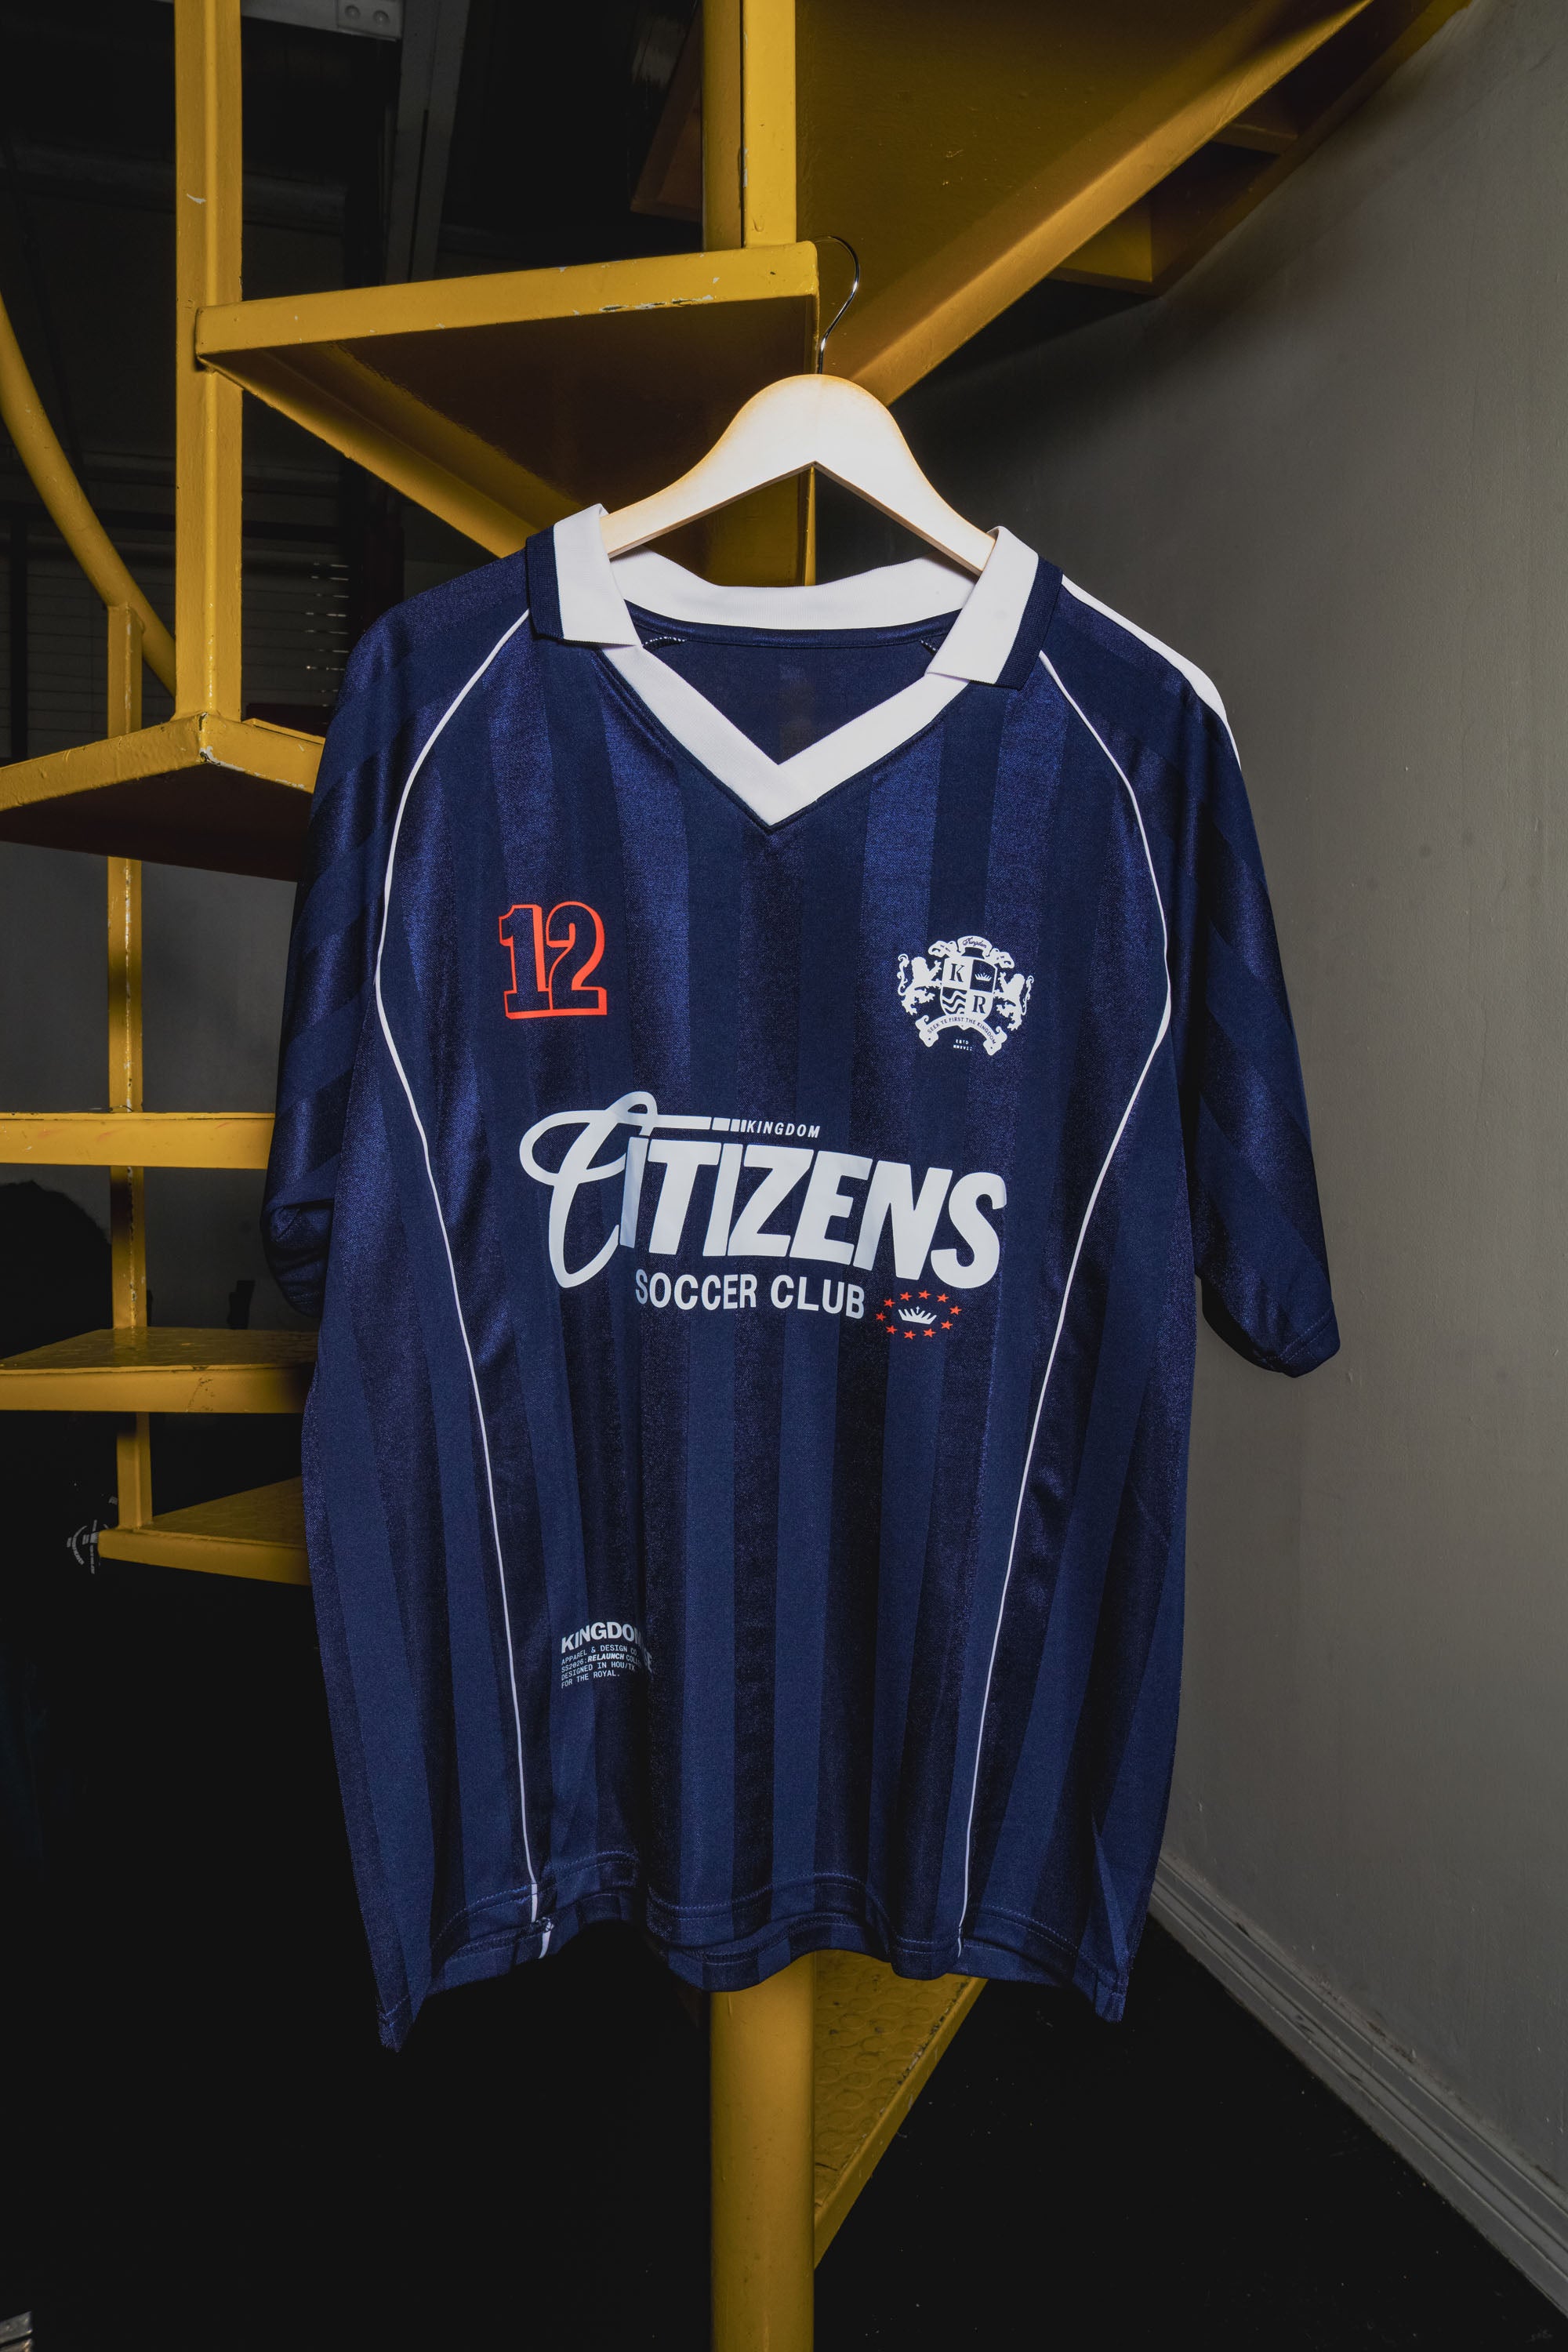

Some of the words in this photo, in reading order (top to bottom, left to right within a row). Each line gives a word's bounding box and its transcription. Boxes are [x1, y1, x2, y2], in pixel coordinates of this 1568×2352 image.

[499, 901, 608, 1020] 12
[949, 964, 964, 982] K
[972, 996, 986, 1014] R
[927, 1023, 940, 1034] SEEK
[976, 1022, 996, 1044] KINGDOM
[747, 1120, 821, 1138] KINGDOM
[519, 1091, 1007, 1288] CITIZENS
[635, 1268, 757, 1310] SOCCER
[771, 1274, 865, 1319] CLUB
[561, 1650, 587, 1665] APPAREL
[561, 1664, 593, 1681] DESIGNED
[561, 1680, 573, 1689] FOR
[576, 1675, 590, 1683] THE
[593, 1670, 620, 1679] ROYAL.
